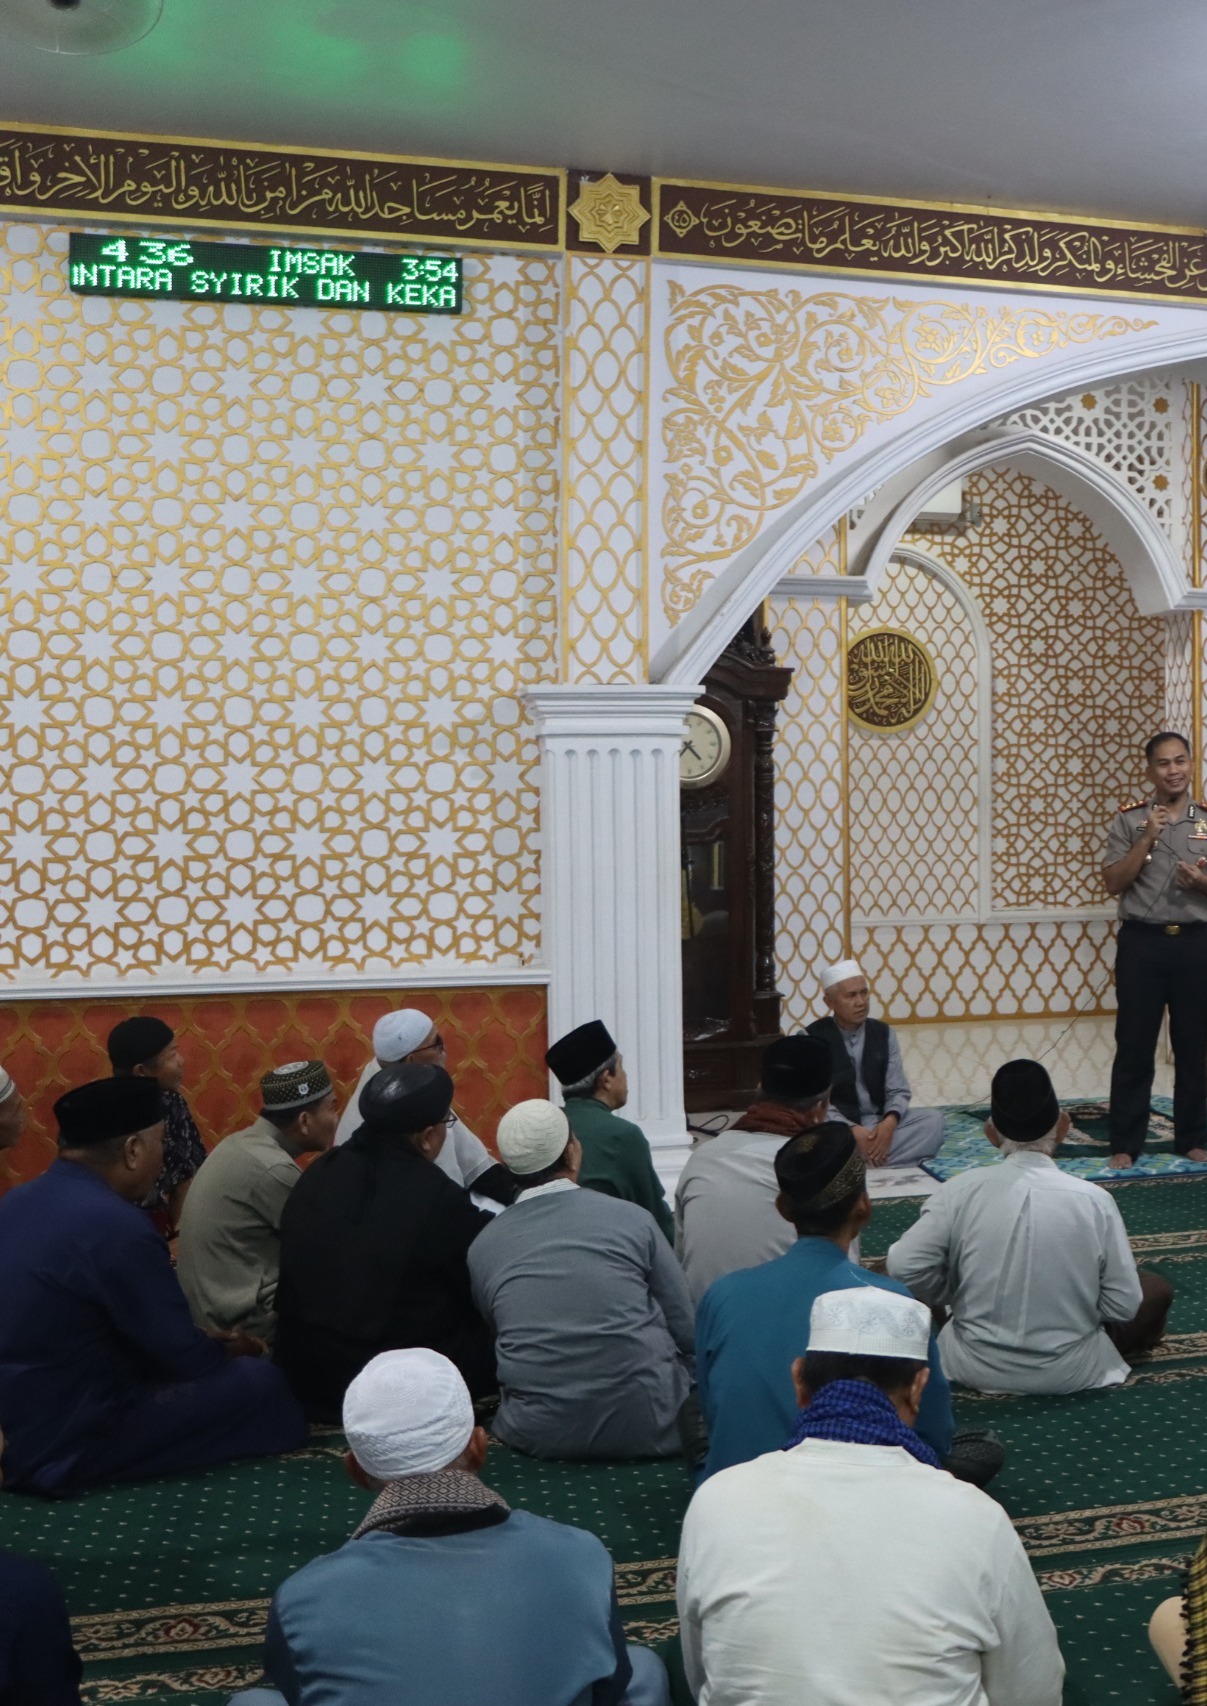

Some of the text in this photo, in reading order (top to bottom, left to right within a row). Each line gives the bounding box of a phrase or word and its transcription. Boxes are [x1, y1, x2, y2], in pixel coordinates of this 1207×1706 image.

[269, 249, 357, 278] IMSAK
[401, 258, 459, 283] 3:54
[191, 271, 299, 299] SYIRIK
[315, 278, 370, 303] DAN
[386, 282, 456, 308] KEKA
